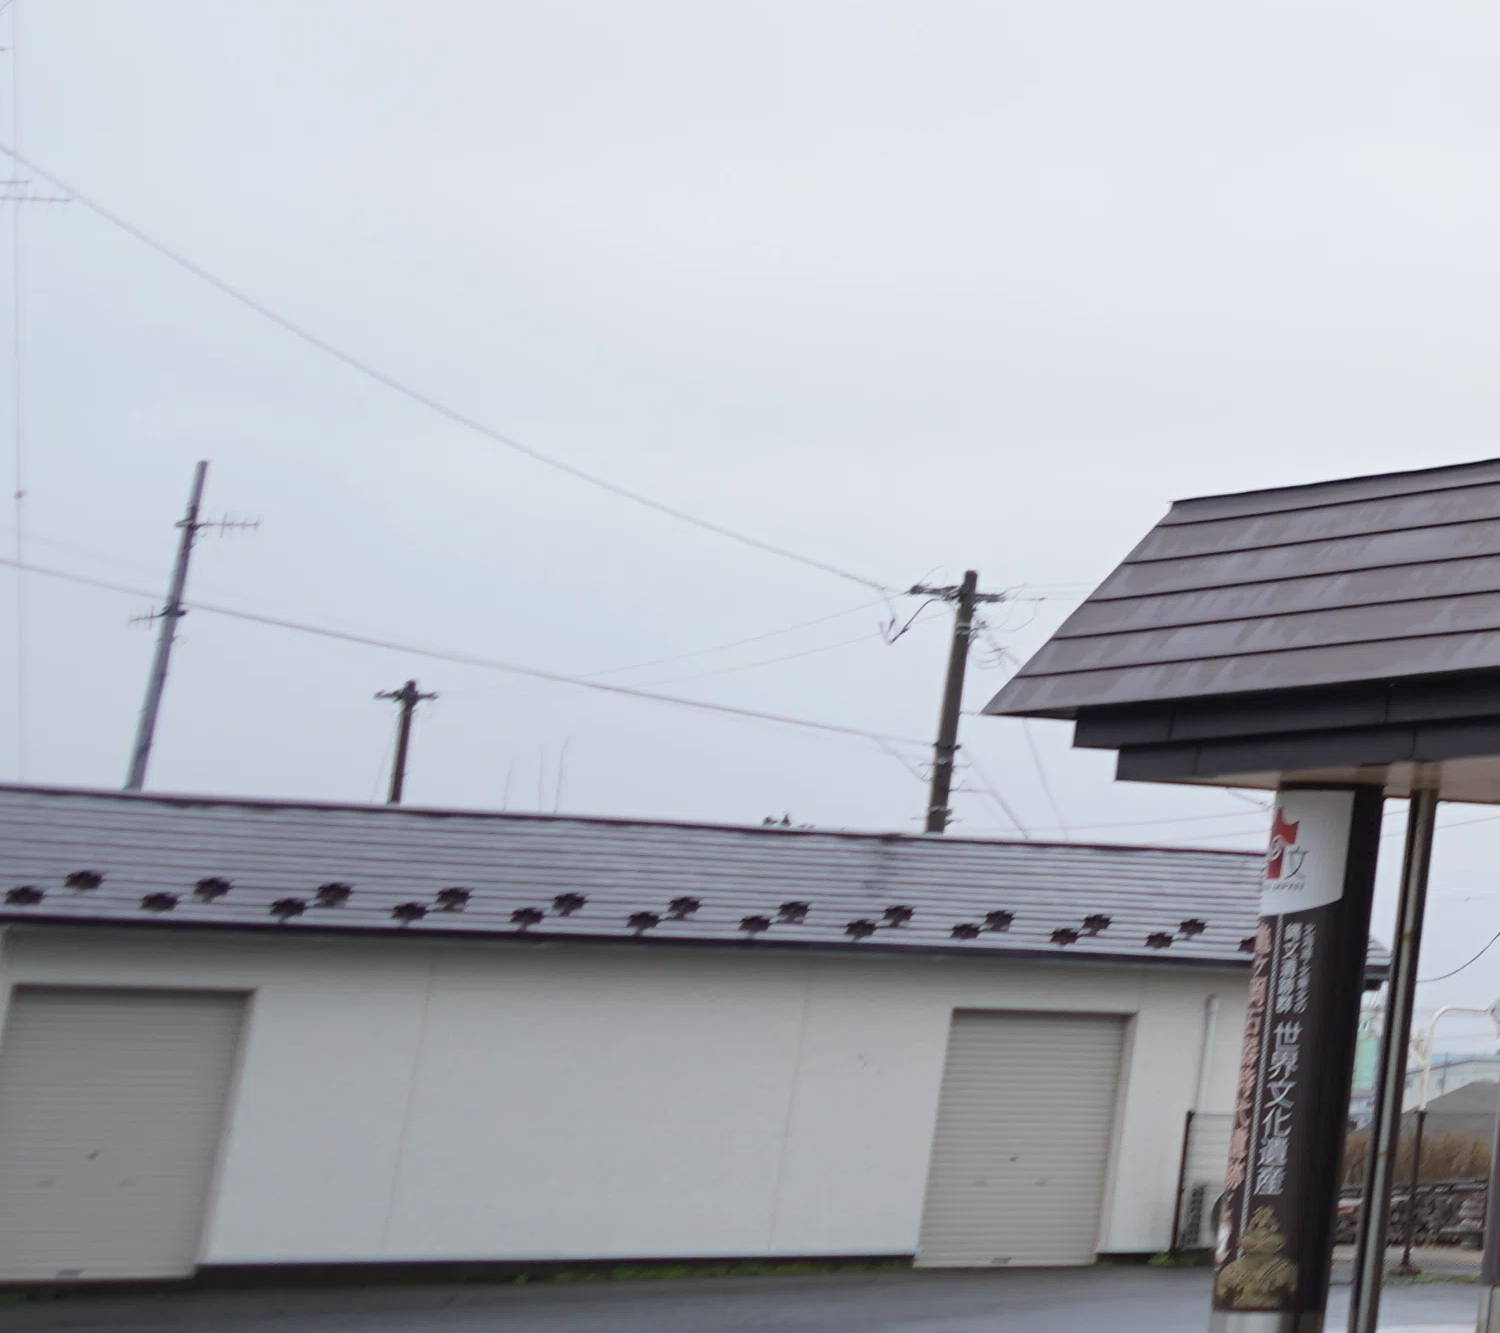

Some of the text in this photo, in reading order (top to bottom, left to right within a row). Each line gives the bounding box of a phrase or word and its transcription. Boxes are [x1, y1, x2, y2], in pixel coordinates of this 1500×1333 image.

[1253, 1018, 1305, 1197] 世界文化遺産
